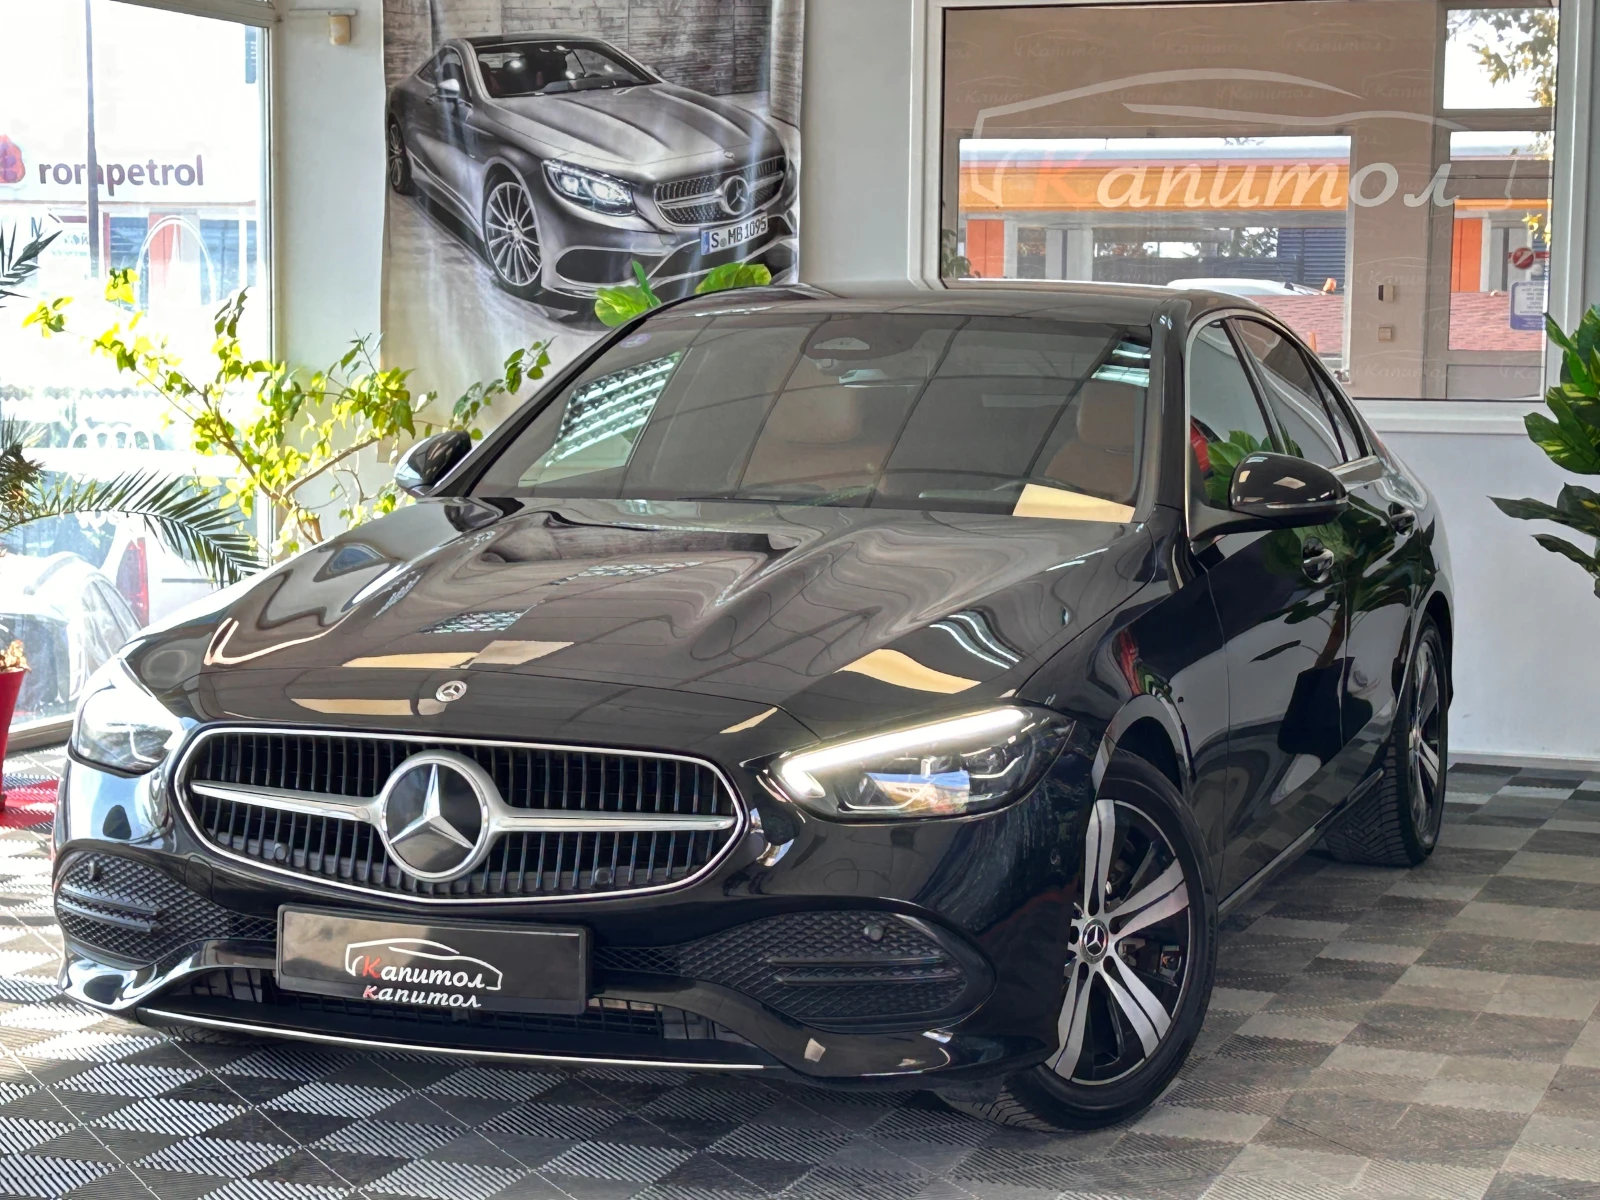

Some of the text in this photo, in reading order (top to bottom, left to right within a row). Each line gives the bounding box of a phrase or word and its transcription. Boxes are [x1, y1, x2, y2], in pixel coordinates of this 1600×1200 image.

[1031, 149, 1461, 208] Капитол
[711, 216, 767, 248] S MB 1095
[362, 955, 485, 988] Капитол
